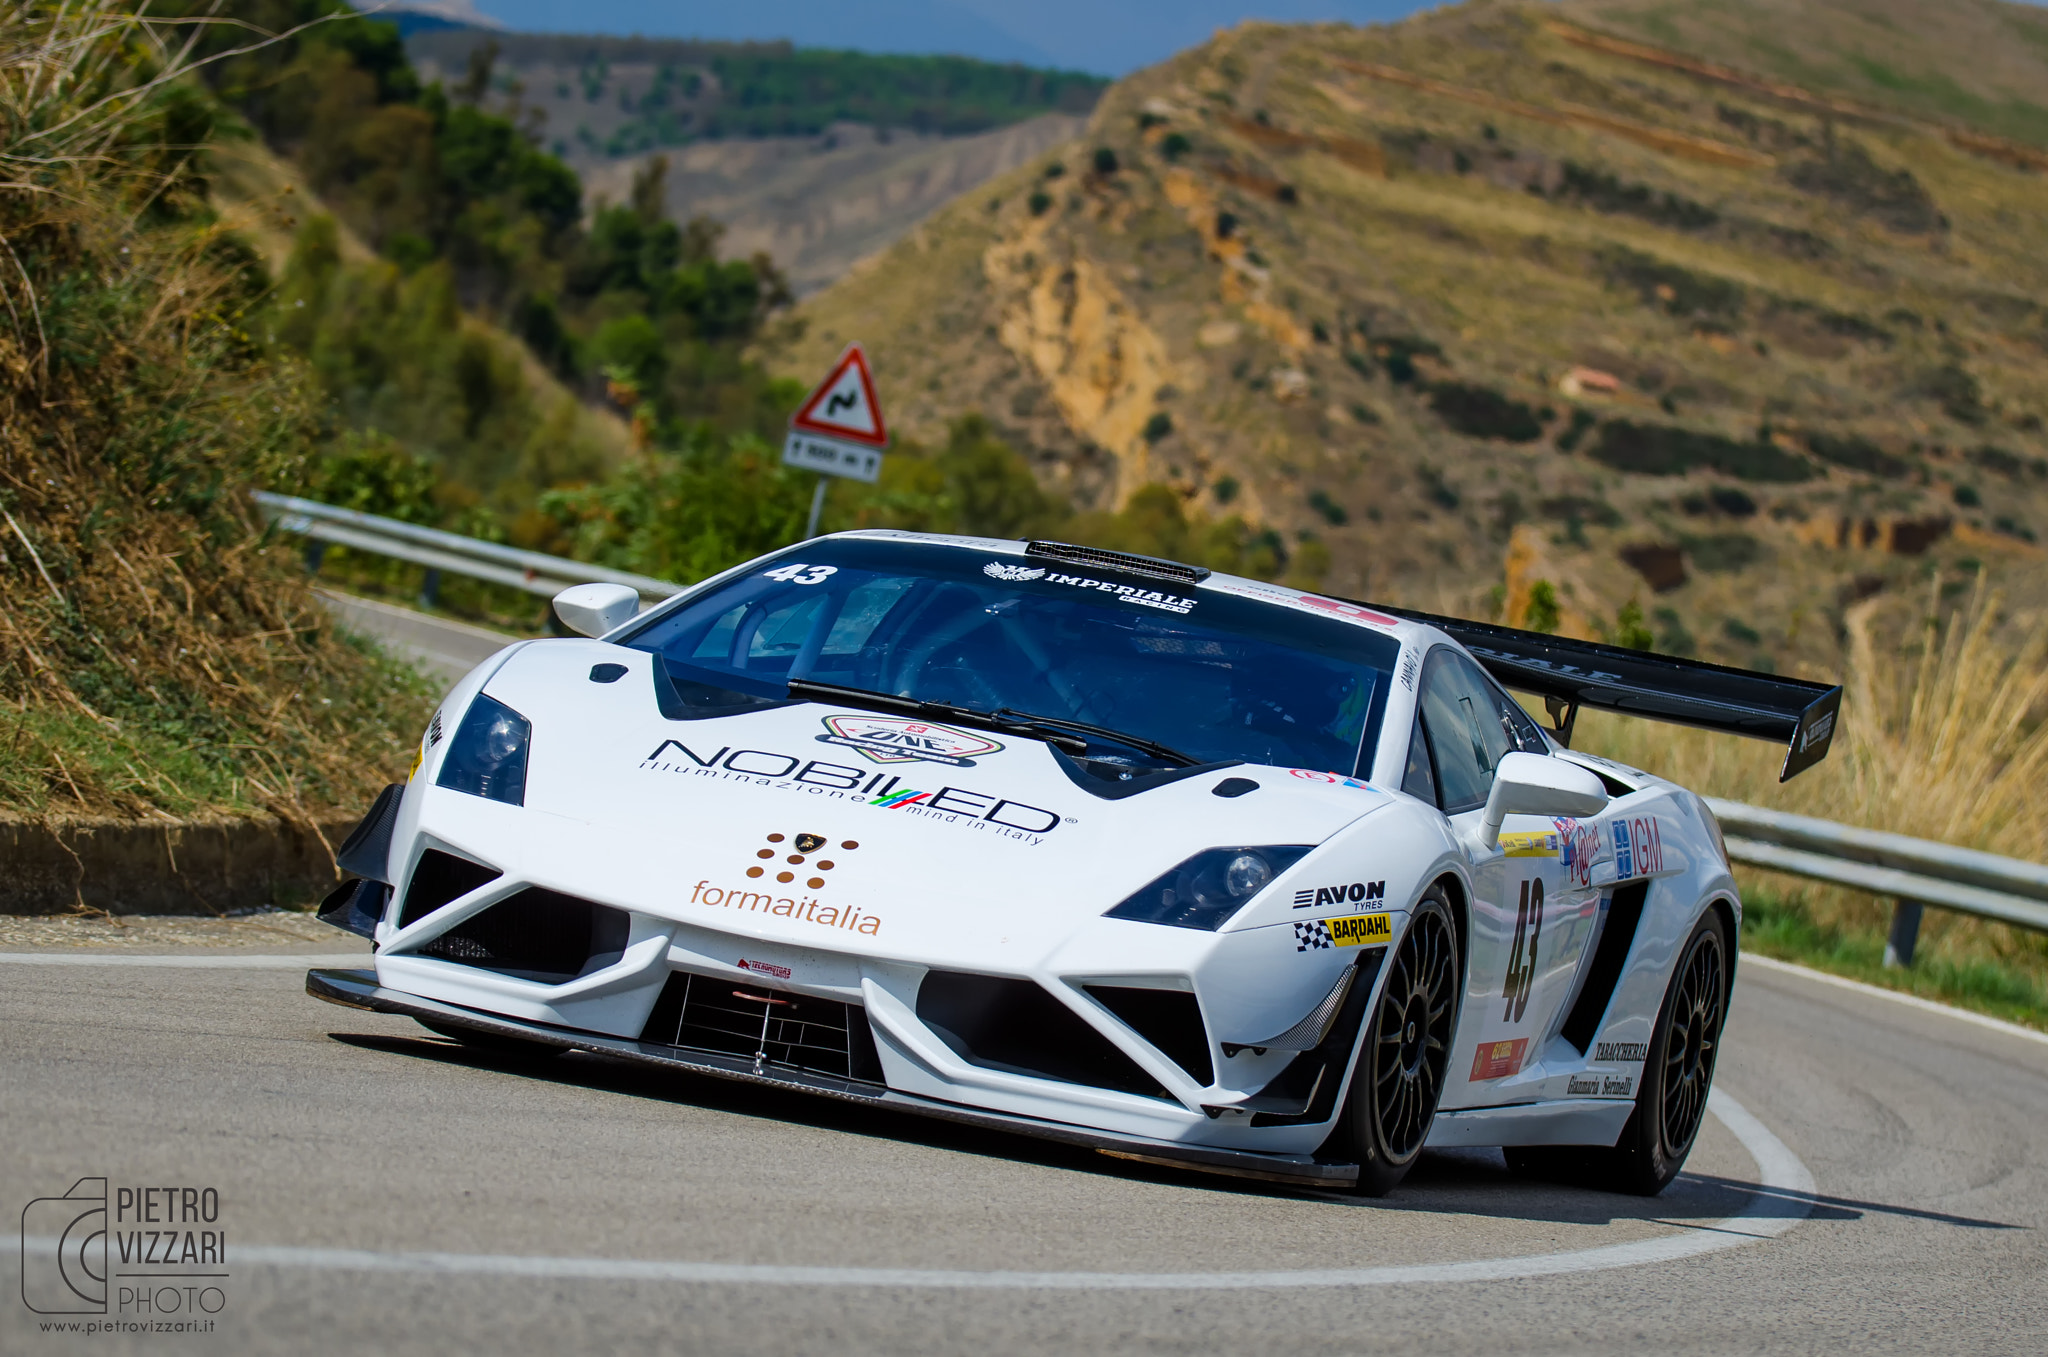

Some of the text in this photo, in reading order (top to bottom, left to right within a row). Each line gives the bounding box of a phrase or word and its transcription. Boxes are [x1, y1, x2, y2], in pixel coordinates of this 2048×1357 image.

[763, 563, 838, 585] 43
[1045, 573, 1198, 609] IMPERIALE
[1121, 595, 1188, 613] RACING
[827, 735, 960, 765] Racing Team
[860, 731, 947, 752] ONE
[639, 760, 866, 803] illuminazione
[906, 805, 1044, 847] mind in italy
[1628, 816, 1663, 876] IGM
[690, 880, 881, 936] formaitalia
[1314, 880, 1386, 907] AVON
[1354, 900, 1383, 911] TYRES
[1333, 916, 1390, 944] BARDAHL
[1502, 877, 1544, 1023] 43
[1595, 1042, 1647, 1062] TABACCHERIA
